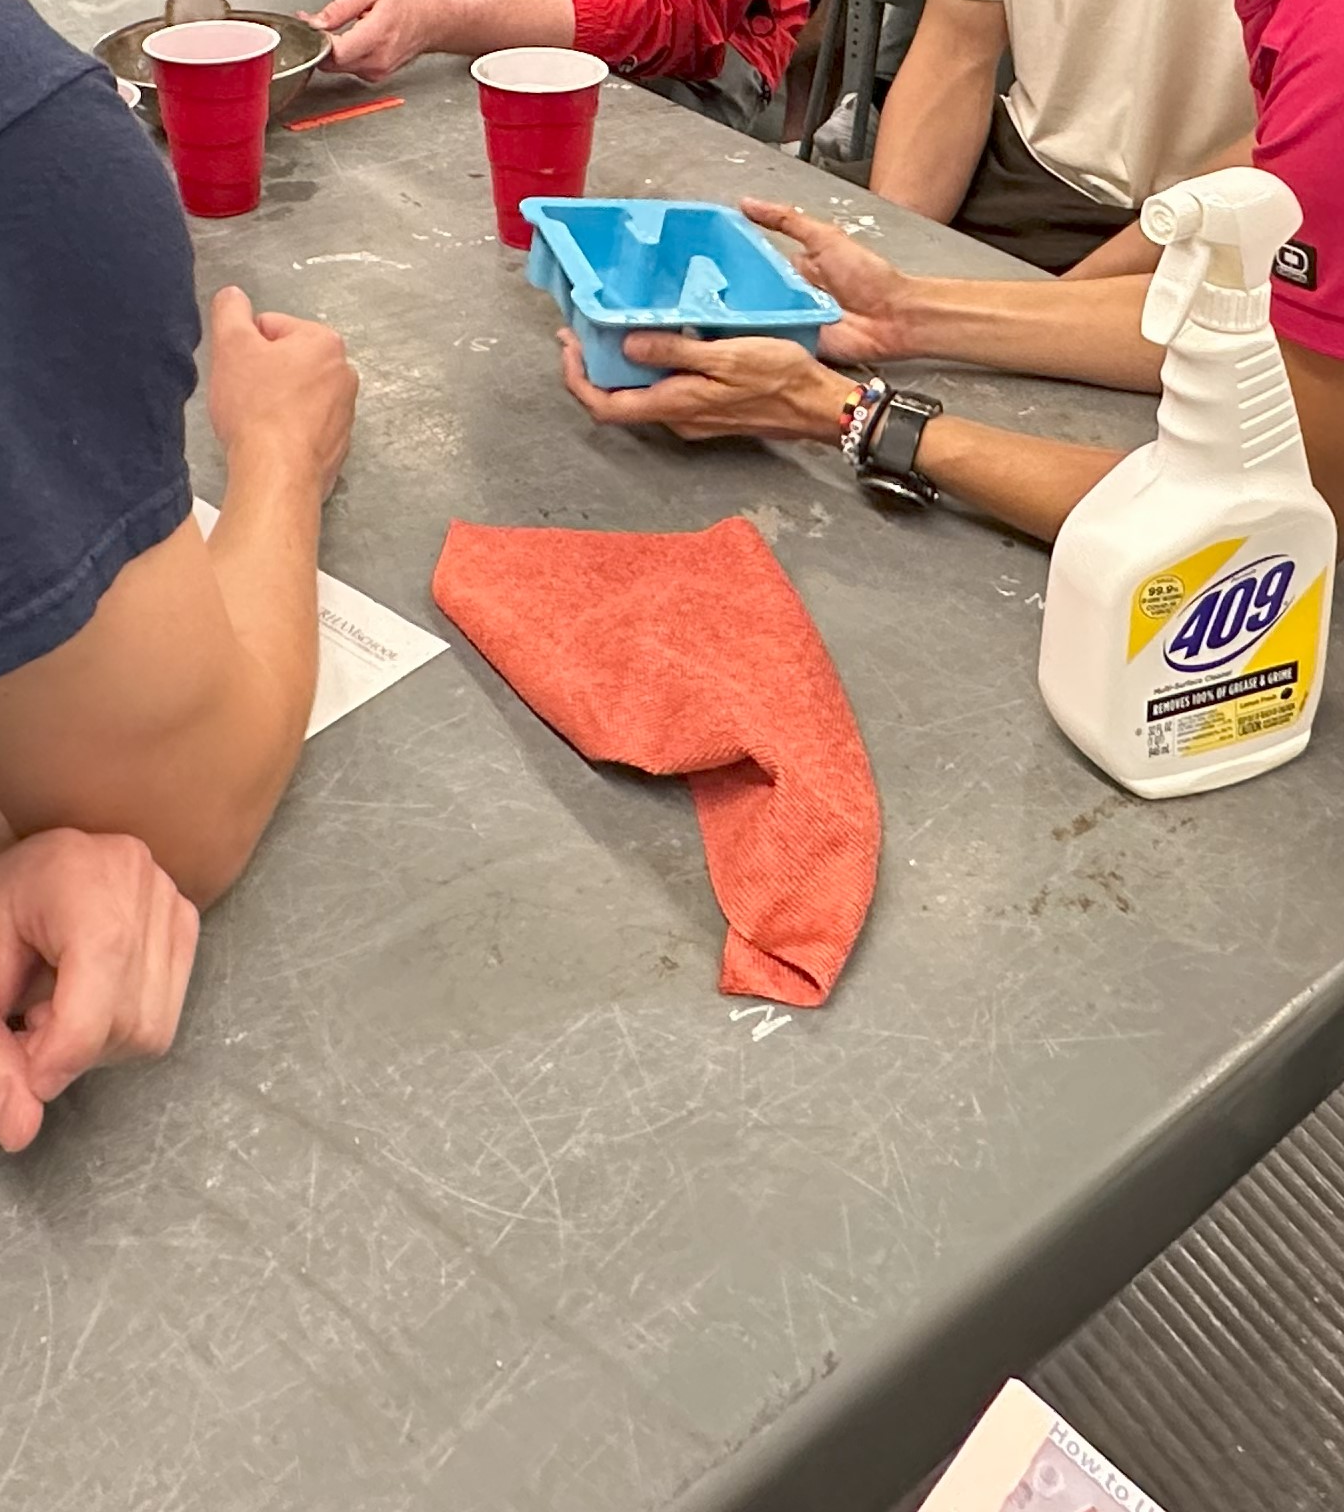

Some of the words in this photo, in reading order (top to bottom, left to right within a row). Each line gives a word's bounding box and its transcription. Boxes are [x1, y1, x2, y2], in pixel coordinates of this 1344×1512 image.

[1169, 560, 1295, 660] 409
[1152, 697, 1191, 716] REMOVES
[1192, 691, 1214, 705] 100%
[1216, 687, 1227, 699] OF
[1228, 676, 1258, 696] GREASE
[1259, 674, 1266, 686] &
[1267, 666, 1293, 684] GRIME
[1049, 1421, 1102, 1475] How
[1105, 1472, 1129, 1501] to
